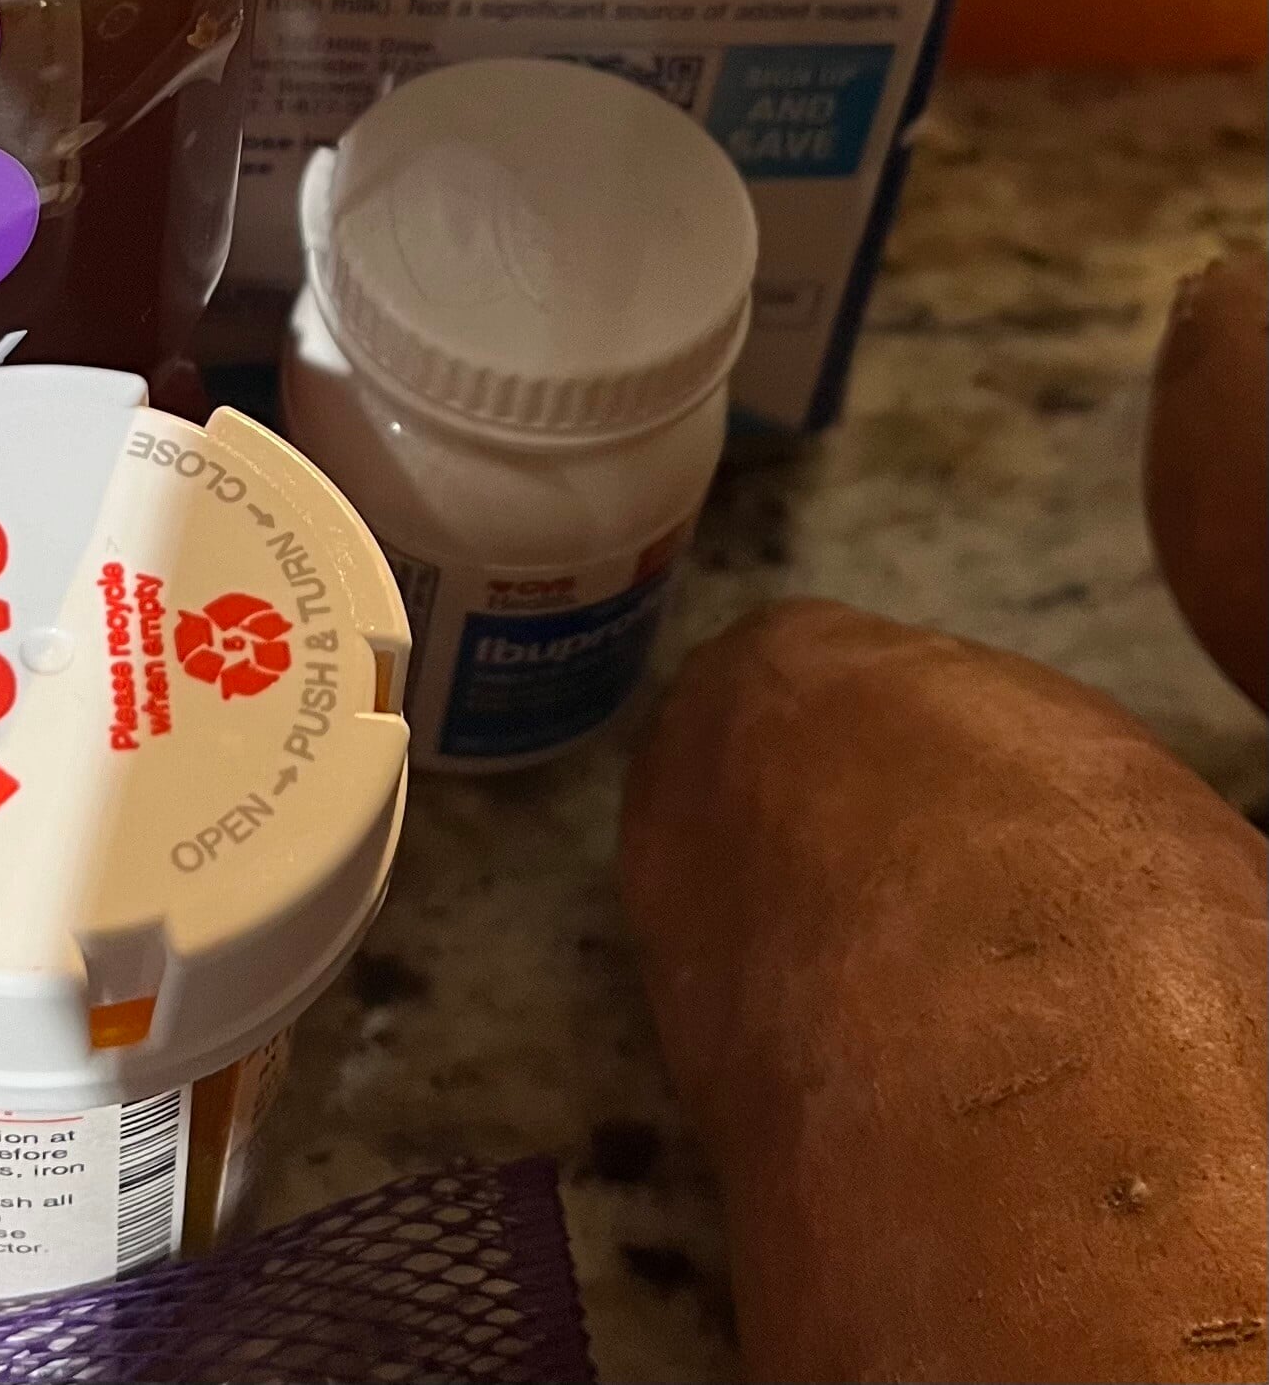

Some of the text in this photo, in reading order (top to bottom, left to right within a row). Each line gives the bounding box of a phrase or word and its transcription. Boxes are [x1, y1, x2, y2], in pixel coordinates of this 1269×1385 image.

[96, 560, 141, 752] Please recycle
[126, 431, 339, 874] OPEN PUSH & TURN CLOSE
[135, 572, 172, 736] when empty
[34, 1161, 86, 1178] iron
[50, 1128, 76, 1143] at
[43, 1192, 74, 1208] all
